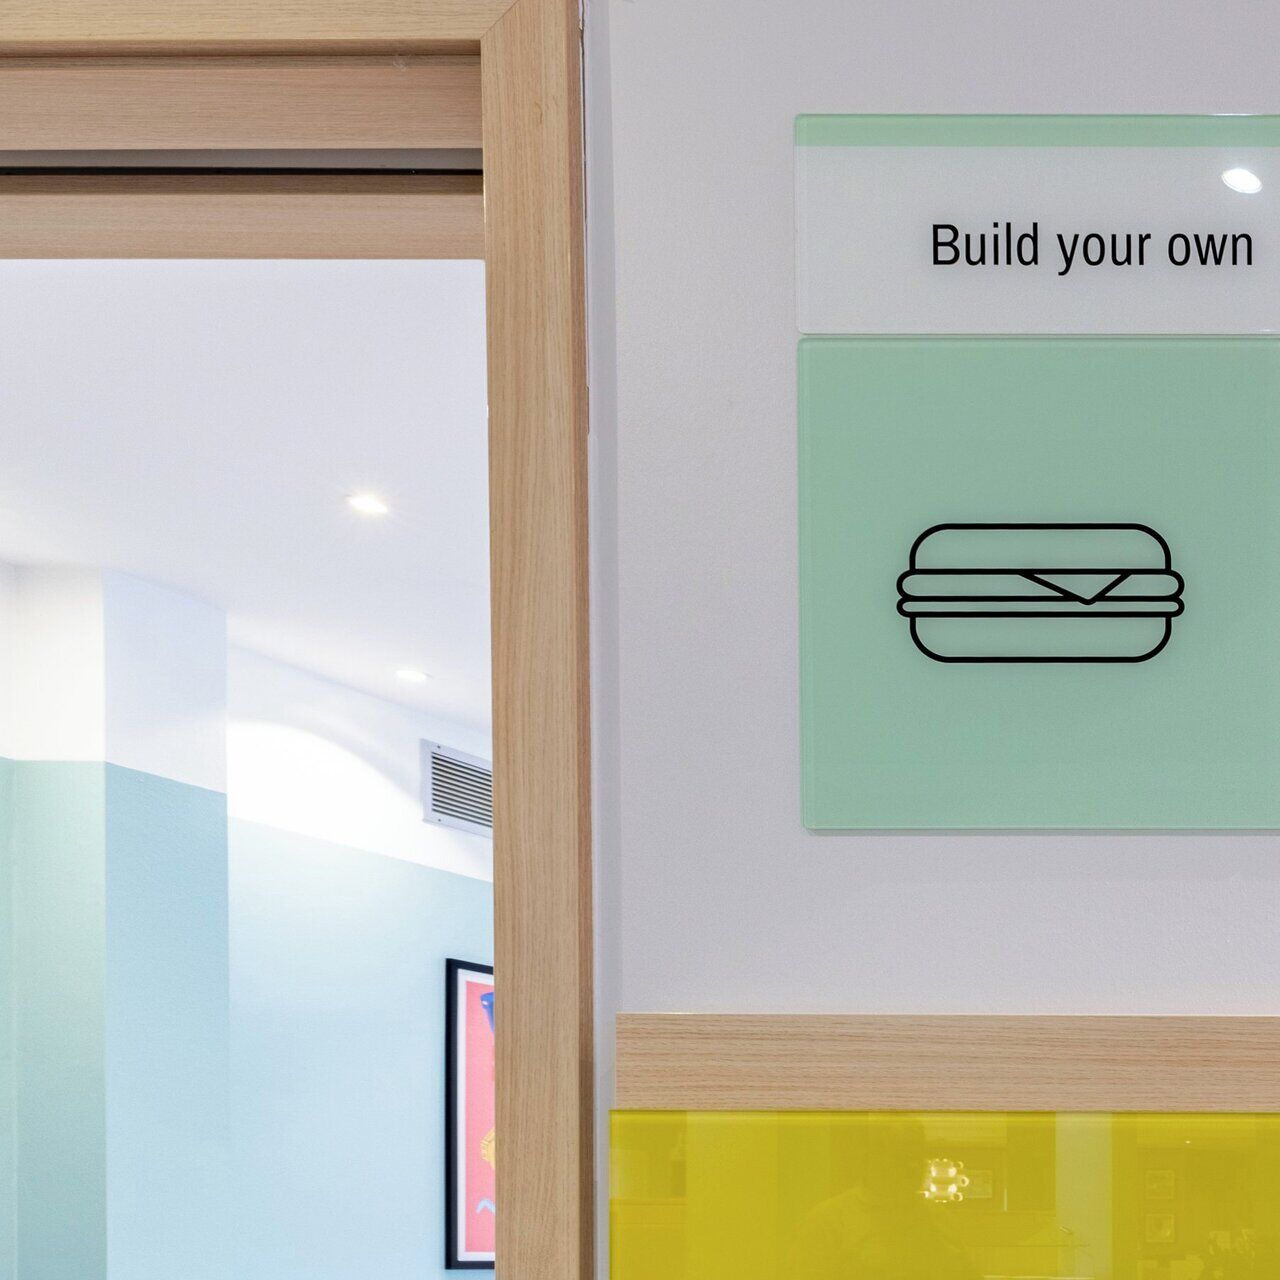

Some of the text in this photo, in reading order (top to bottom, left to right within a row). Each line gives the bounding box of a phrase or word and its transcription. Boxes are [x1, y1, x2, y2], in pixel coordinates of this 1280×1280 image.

[933, 222, 1039, 267] Build
[1056, 232, 1152, 277] your
[1167, 233, 1253, 267] own
